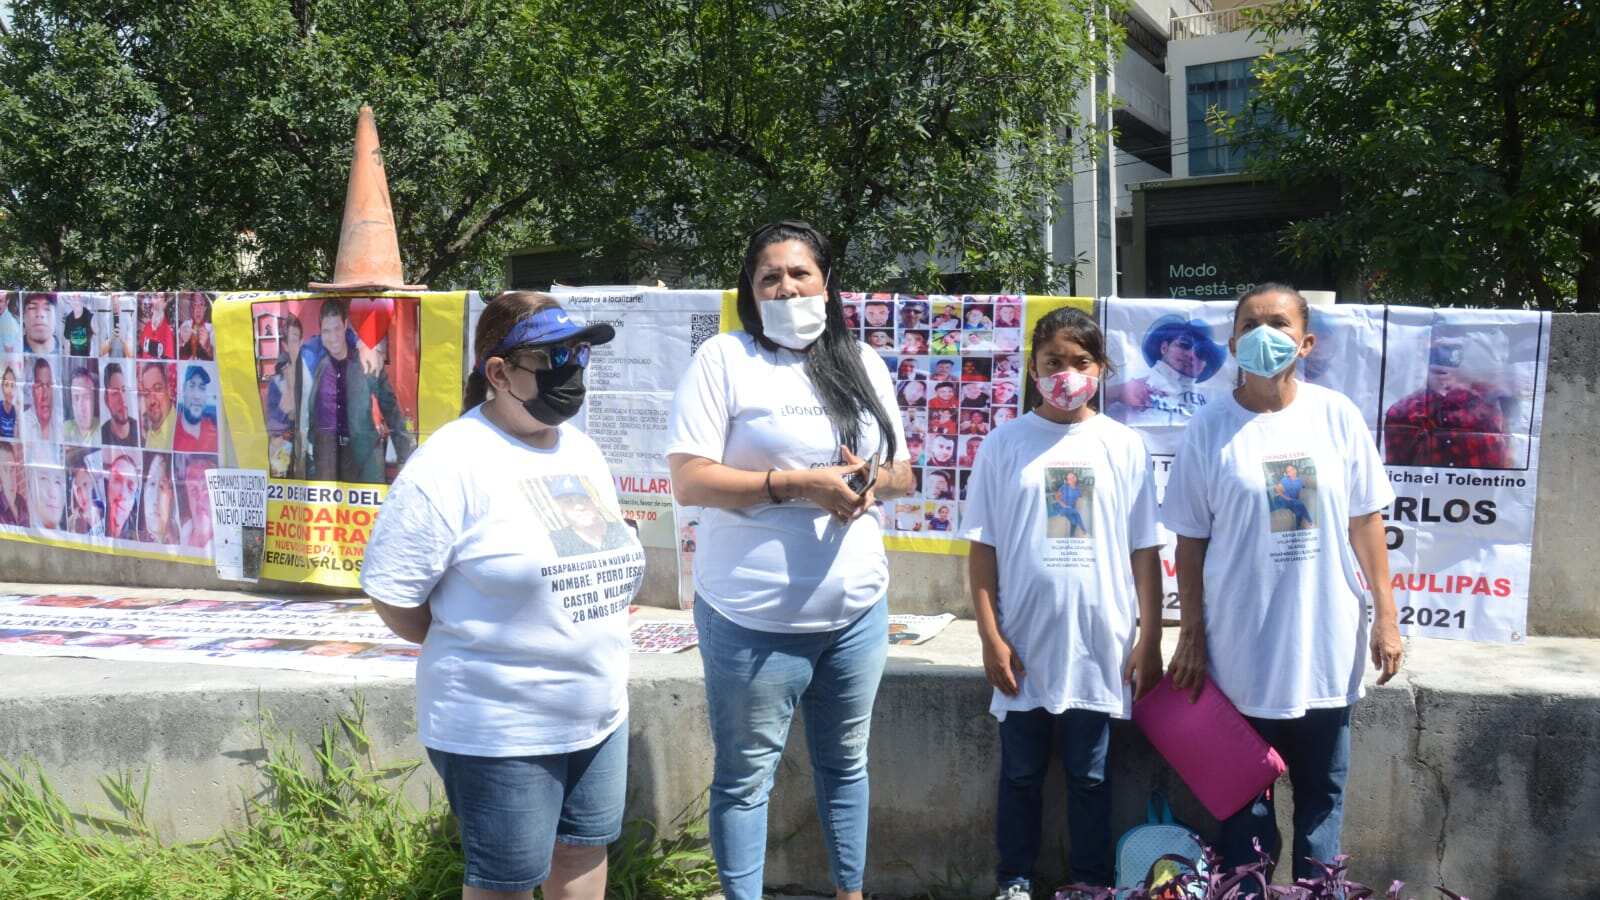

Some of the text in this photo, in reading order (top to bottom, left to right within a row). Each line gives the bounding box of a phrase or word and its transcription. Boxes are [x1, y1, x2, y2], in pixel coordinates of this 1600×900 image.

[1169, 263, 1217, 278] Modo
[209, 475, 240, 490] HERMANOS
[1386, 470, 1526, 488] ichael Tolentino
[267, 485, 283, 499] 22
[216, 509, 264, 527] NUEVO LAREDO
[541, 559, 597, 577] DESAPARECIDO
[597, 568, 623, 584] PEDRO
[563, 591, 598, 608] CASTRO
[573, 610, 585, 623] 28
[588, 604, 609, 620] AÑOS
[1400, 606, 1466, 629] 2021
